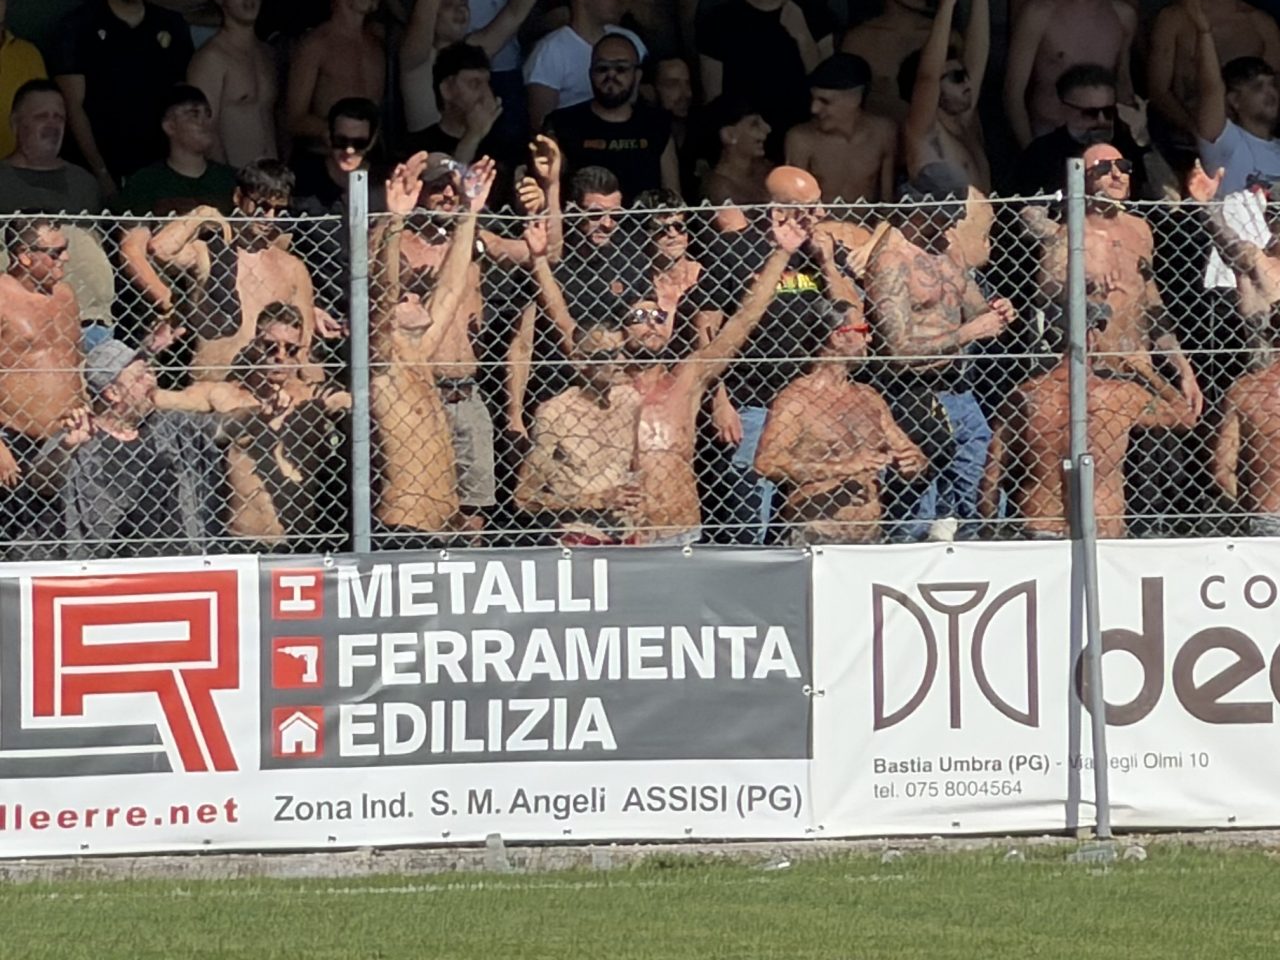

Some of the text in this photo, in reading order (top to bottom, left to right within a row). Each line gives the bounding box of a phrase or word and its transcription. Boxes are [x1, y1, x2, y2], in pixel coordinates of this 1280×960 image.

[338, 557, 610, 619] METALLI
[338, 626, 802, 688] FERRAMENTA
[338, 696, 618, 759] EDILIZIA
[873, 756, 932, 774] Bastia
[939, 754, 1002, 772] Umbra
[1008, 754, 1050, 775] (PG)
[1109, 752, 1138, 773] egli
[1143, 751, 1183, 769] Olmi
[1190, 751, 1209, 768] 10
[274, 784, 803, 822] Zona Ind. S. M. Angeli ASSISI (PG)
[873, 780, 1022, 798] tel. 075 8004564
